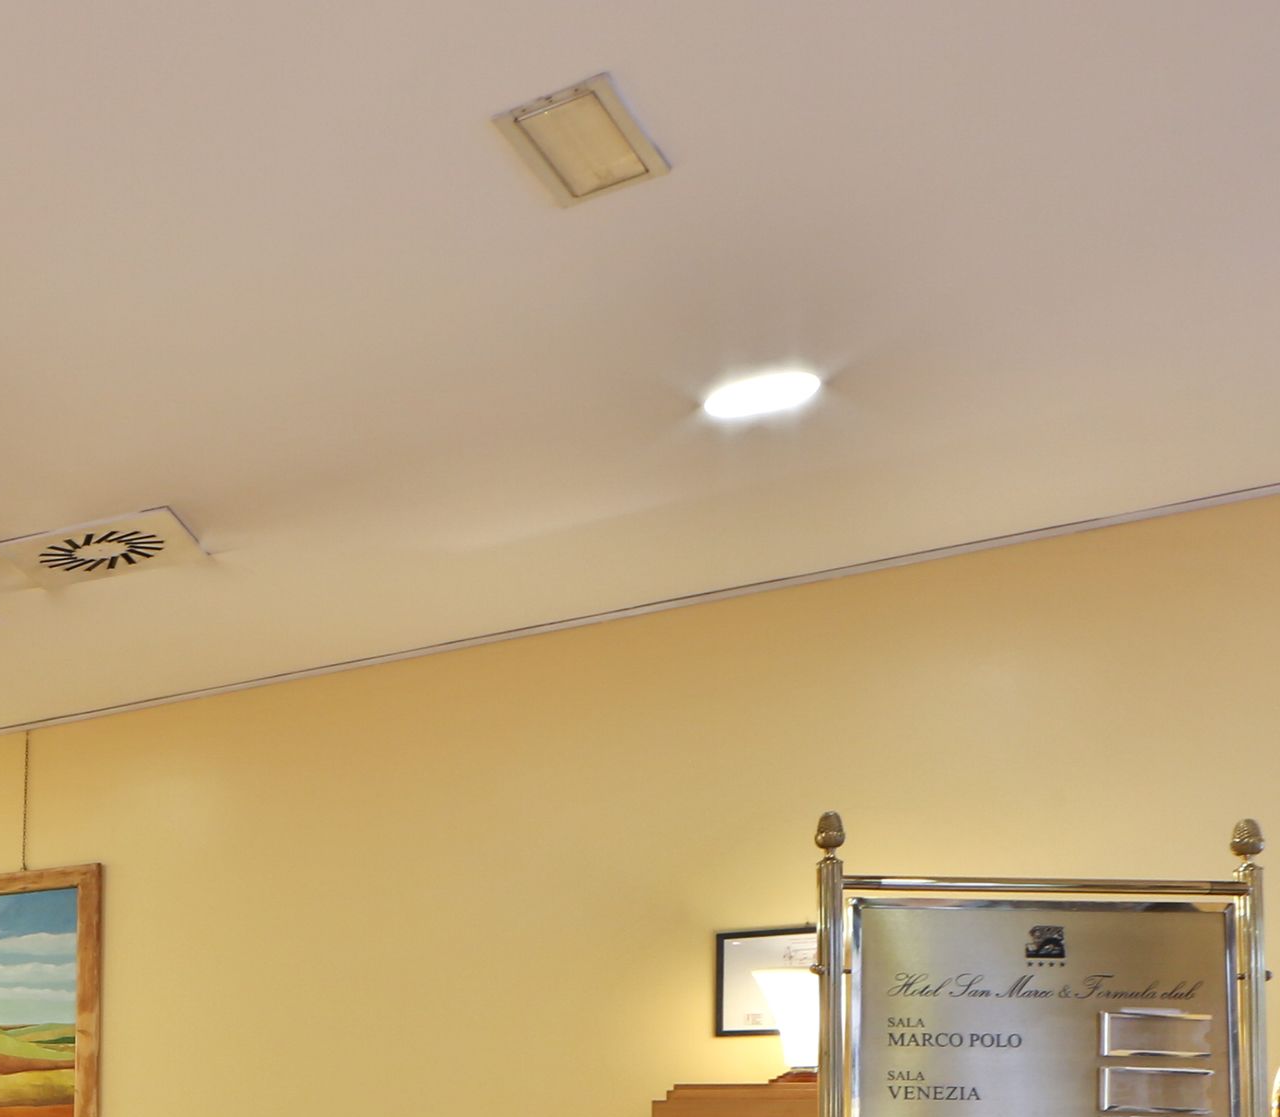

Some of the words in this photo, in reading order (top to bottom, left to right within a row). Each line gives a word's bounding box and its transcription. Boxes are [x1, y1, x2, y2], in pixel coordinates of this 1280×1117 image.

[887, 973, 950, 998] Hotel
[950, 974, 992, 998] San
[995, 975, 1053, 998] Marco
[1058, 986, 1071, 999] &
[1075, 975, 1159, 1000] Formula
[1160, 981, 1204, 1000] club
[887, 1017, 925, 1028] SALA
[887, 1033, 963, 1048] MARCO
[969, 1034, 1022, 1048] POLO
[887, 1070, 925, 1081] SALA
[887, 1085, 980, 1101] VENEZIA
